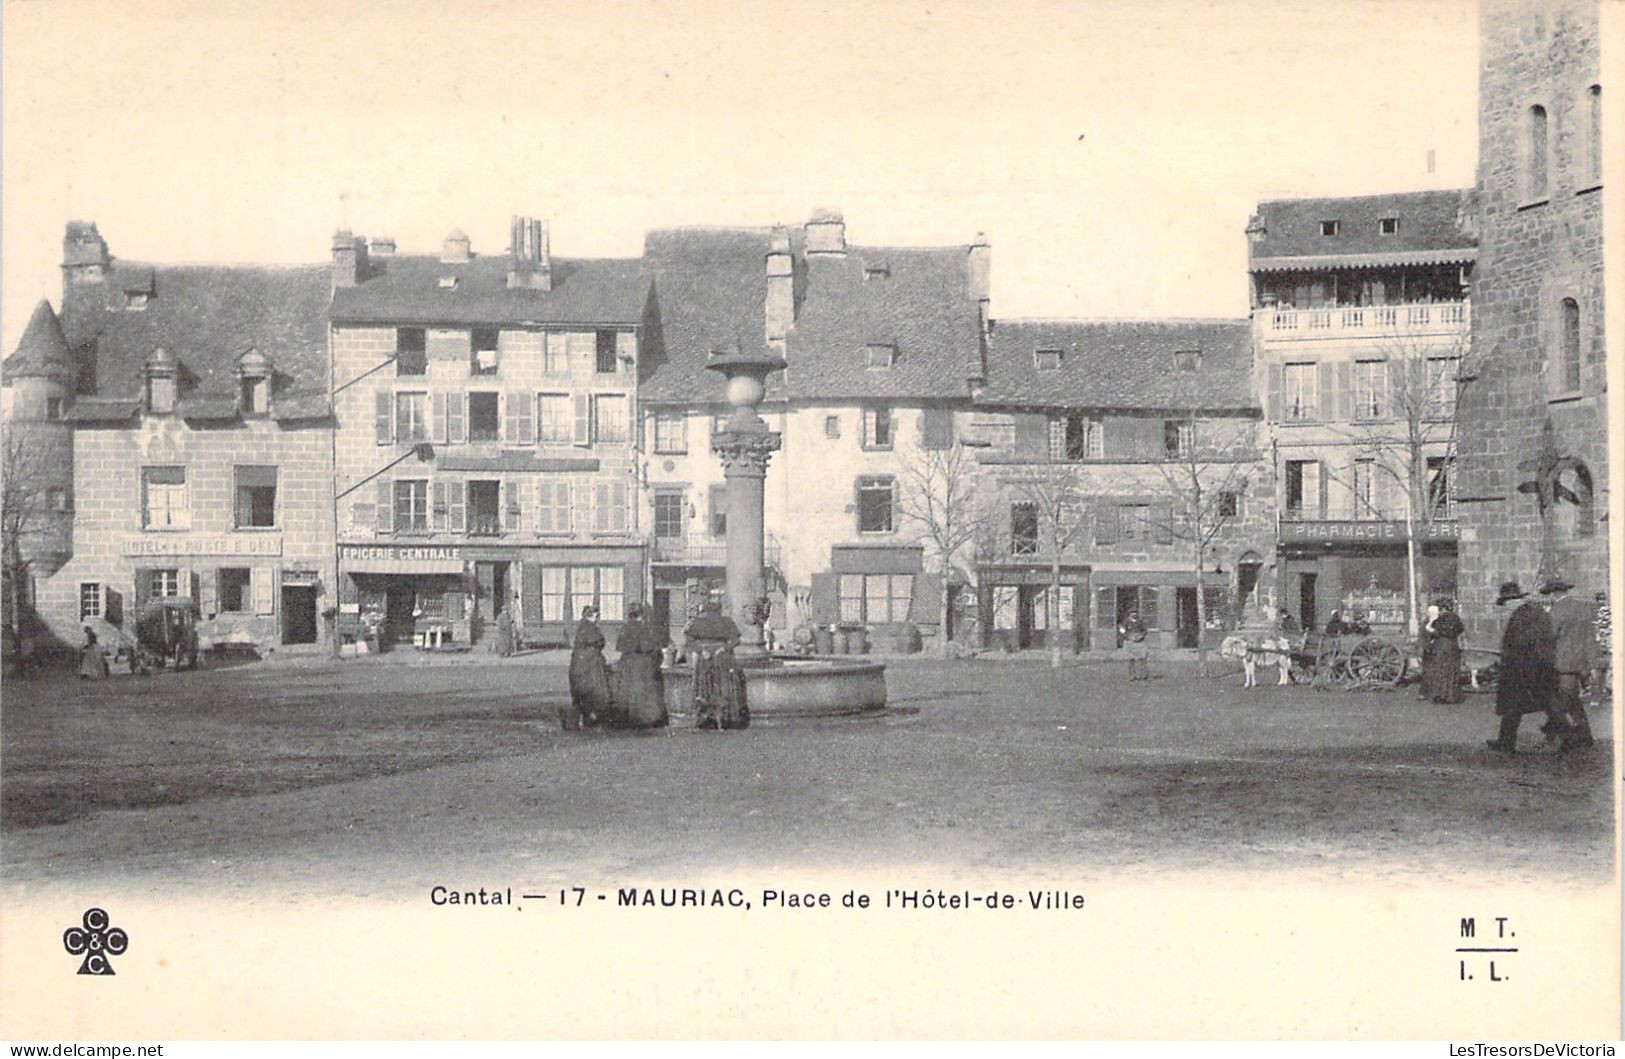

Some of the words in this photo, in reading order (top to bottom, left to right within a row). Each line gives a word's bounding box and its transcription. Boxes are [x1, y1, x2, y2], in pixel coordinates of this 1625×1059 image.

[1295, 524, 1395, 538] PHARMACIE
[343, 547, 395, 561] EPICERIE
[400, 547, 461, 560] CENTRALE
